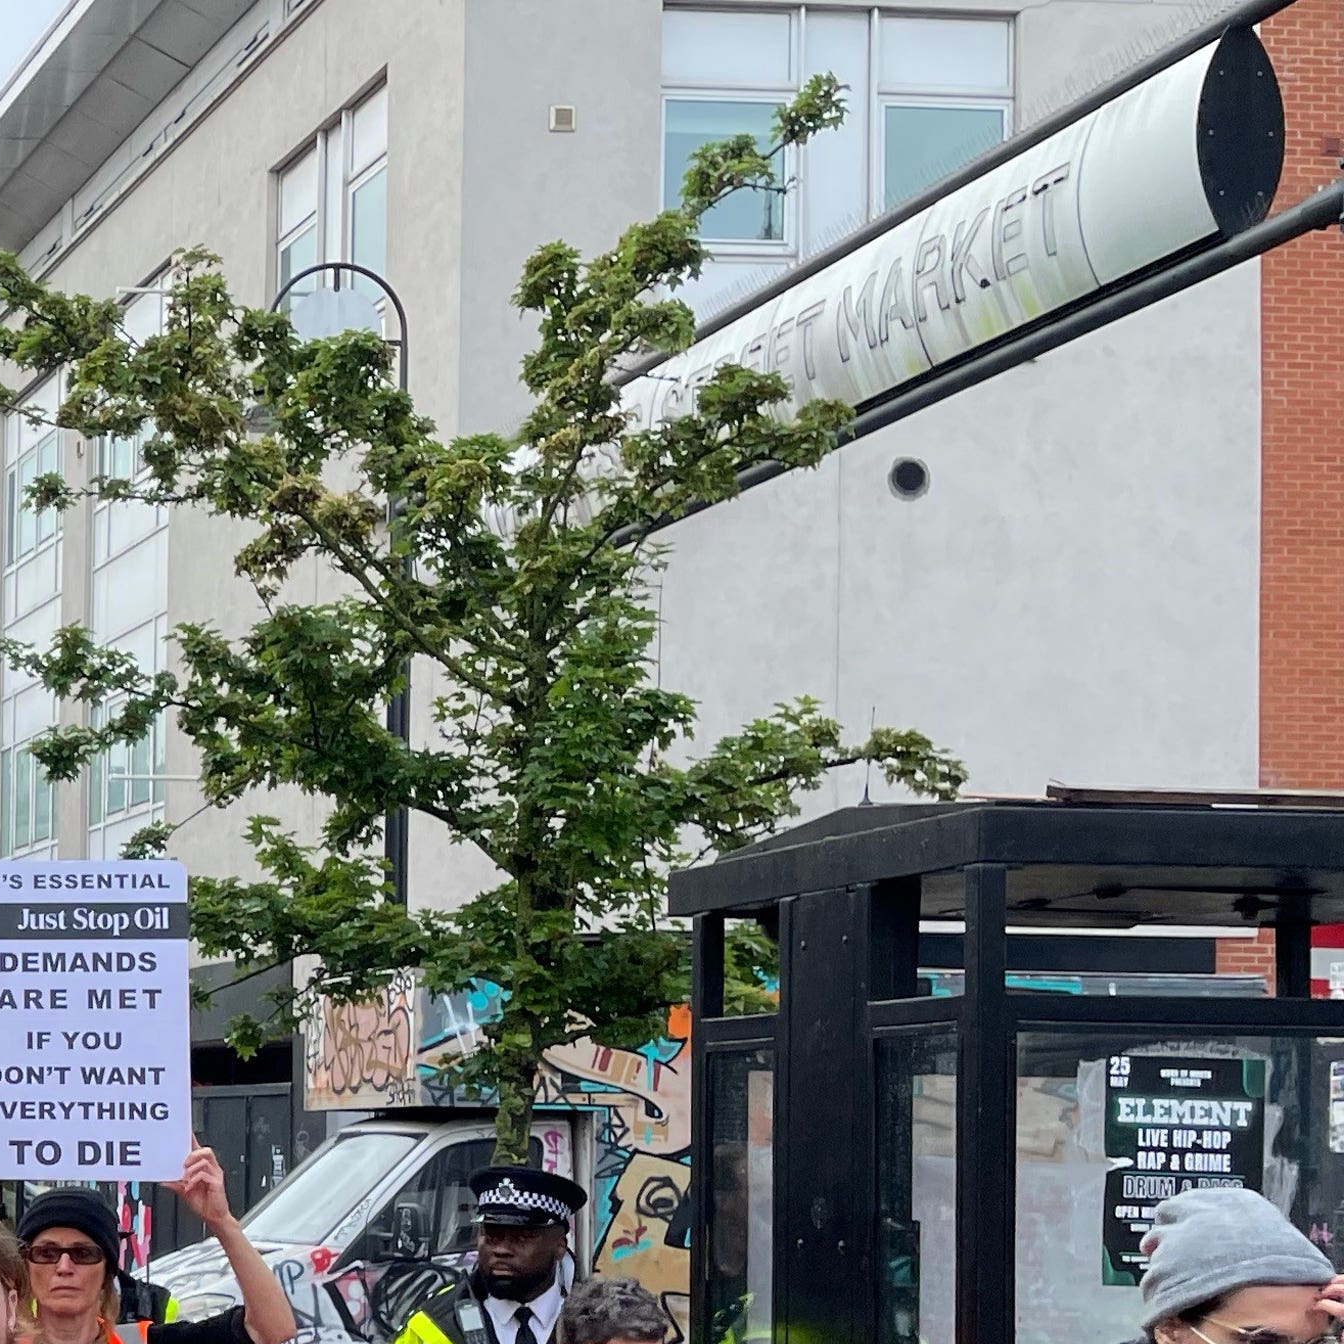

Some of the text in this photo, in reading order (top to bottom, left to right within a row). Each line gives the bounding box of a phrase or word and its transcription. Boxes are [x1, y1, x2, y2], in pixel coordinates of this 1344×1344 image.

[835, 161, 1071, 364] MARKET
[33, 873, 170, 890] ESSENTIAL
[17, 906, 171, 937] Just Stop Oil
[87, 988, 163, 1010] MET
[27, 1031, 123, 1051] IF YOU
[80, 1066, 166, 1086] WANT
[1110, 1056, 1131, 1076] 25
[1117, 1097, 1253, 1127] ELEMENT
[1138, 1128, 1232, 1150] LIVE HIP-HOP
[8, 1139, 142, 1167] TO DIE
[1137, 1151, 1232, 1173] RAP & GRIME
[1123, 1175, 1176, 1199] DRUM
